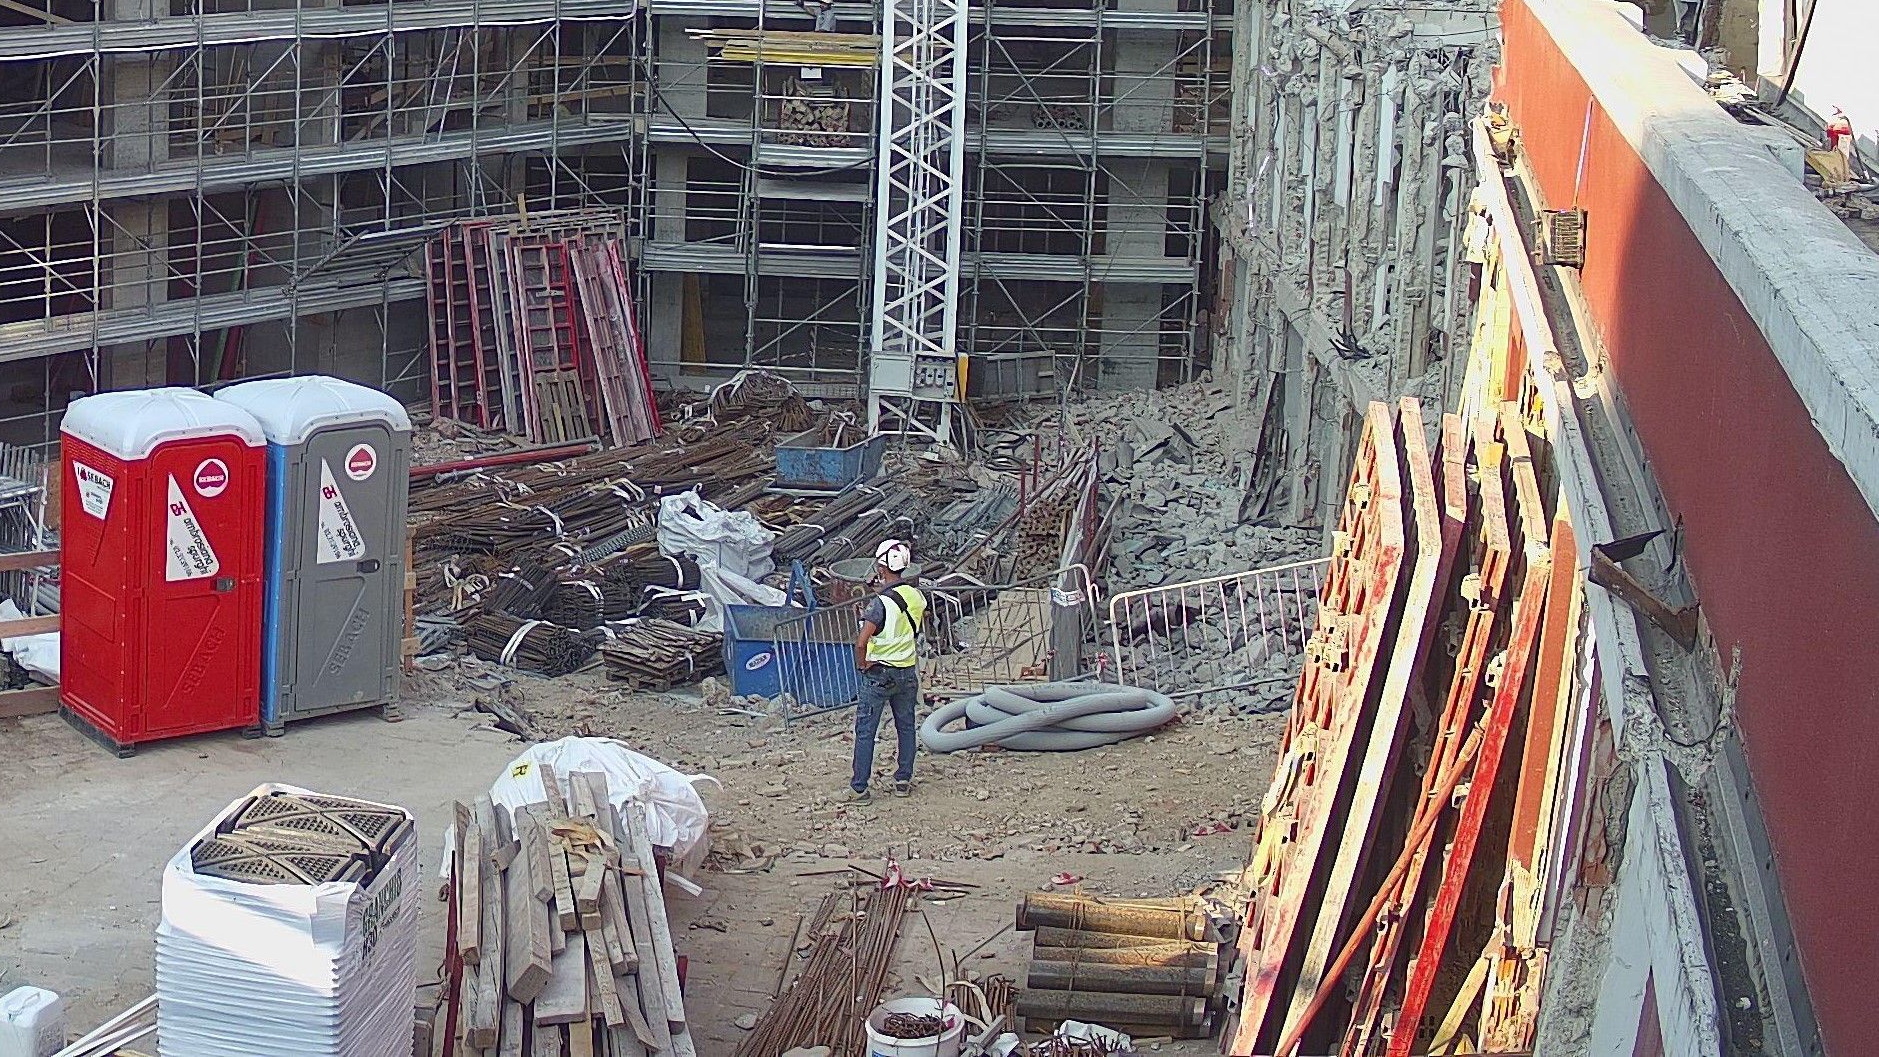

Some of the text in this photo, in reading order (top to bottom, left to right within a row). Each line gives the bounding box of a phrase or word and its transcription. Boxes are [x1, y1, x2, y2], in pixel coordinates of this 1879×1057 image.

[87, 470, 111, 489] SEBACH
[183, 517, 213, 566] ambrosiana
[334, 500, 361, 548] ambrosiana
